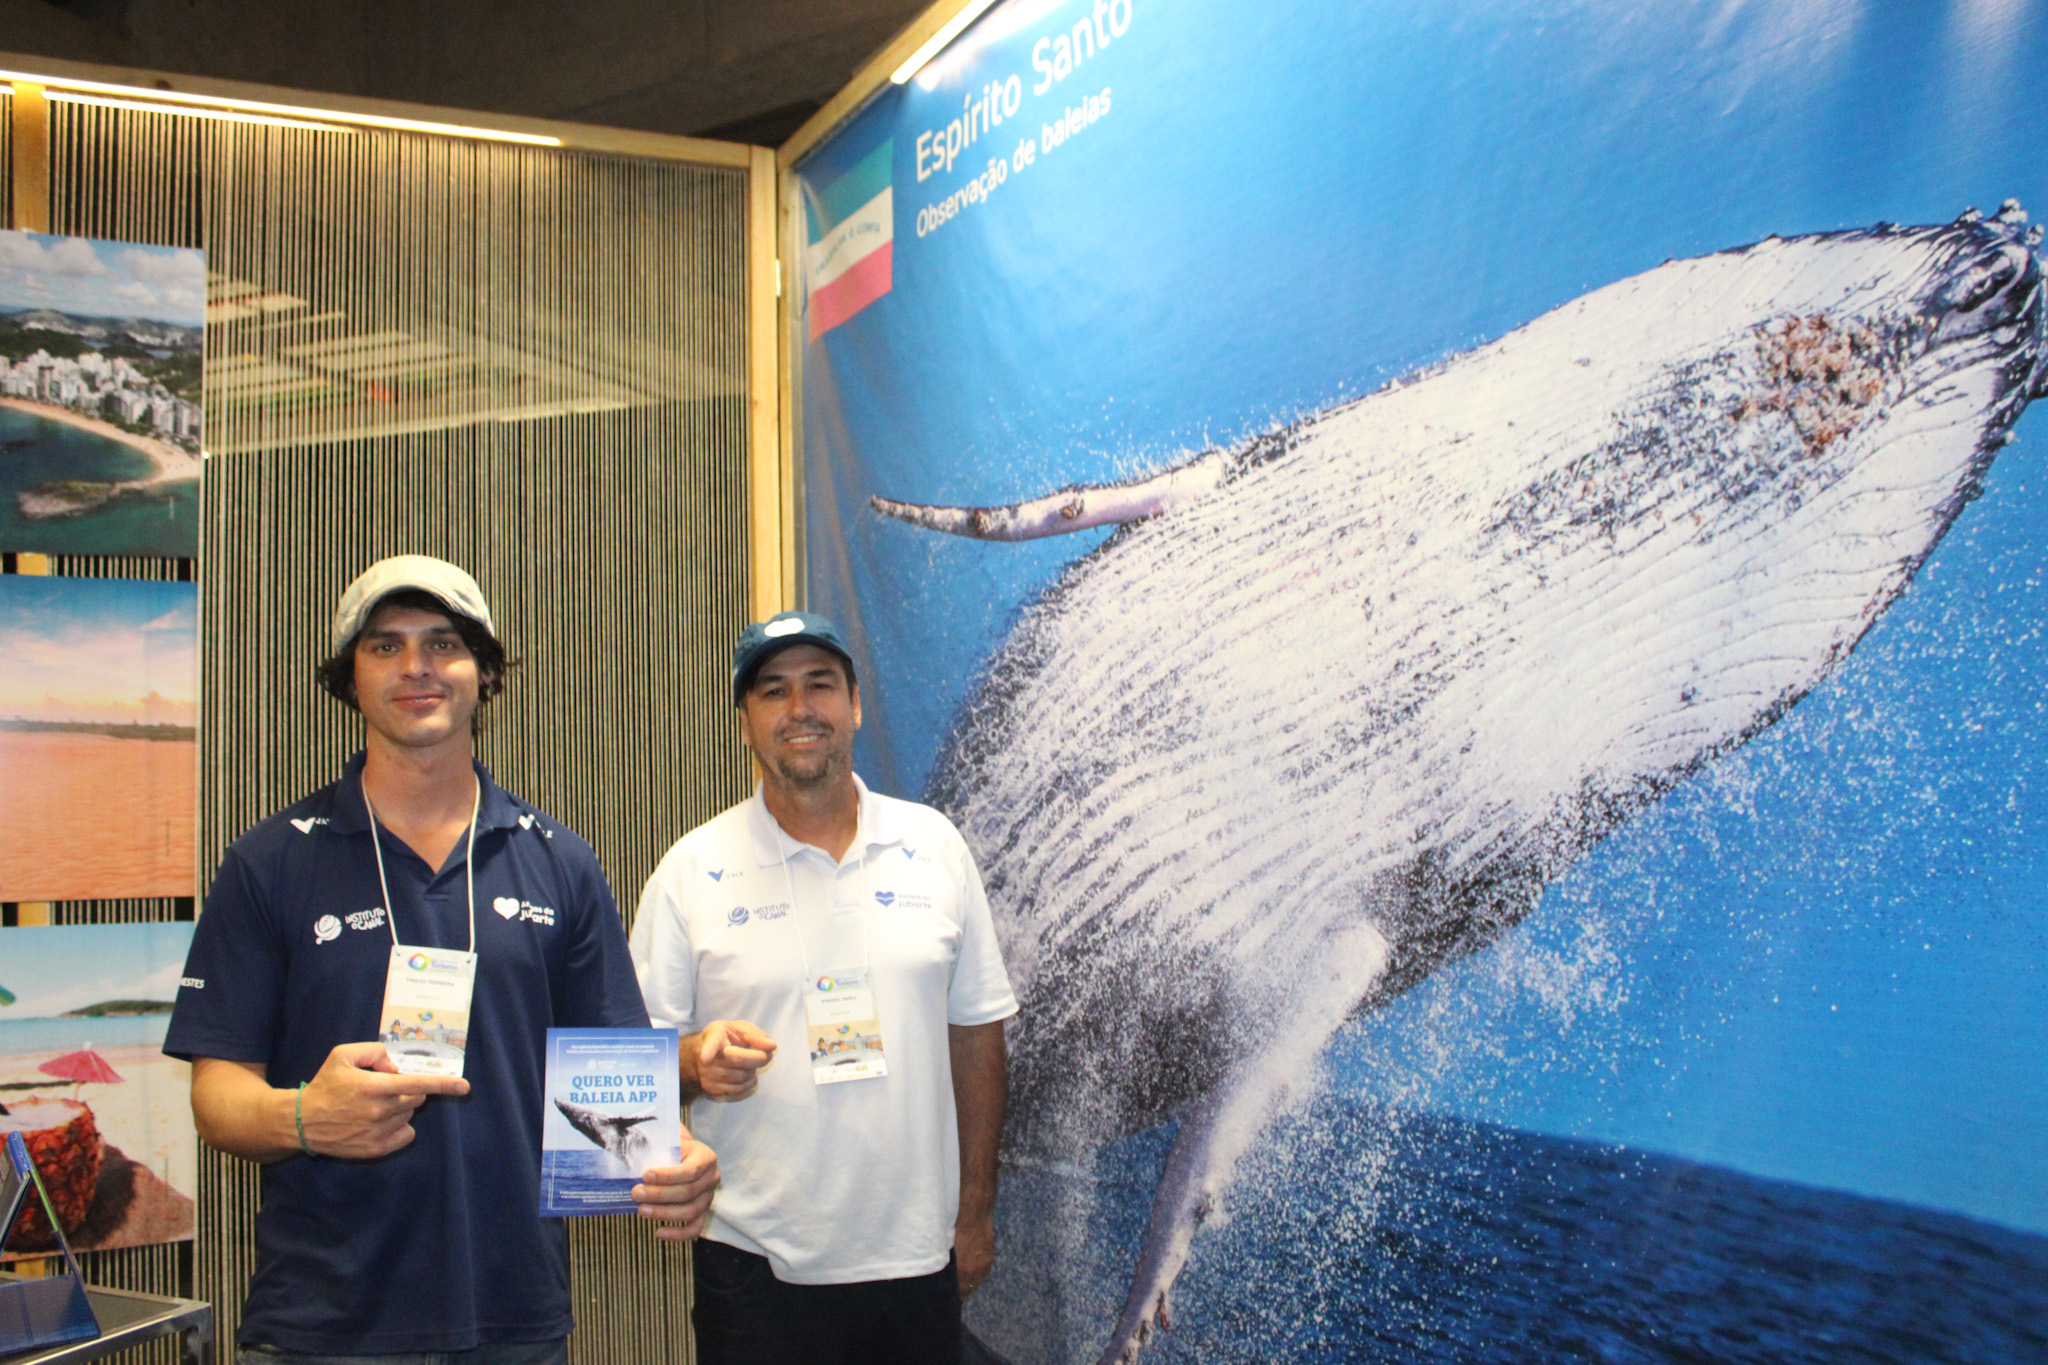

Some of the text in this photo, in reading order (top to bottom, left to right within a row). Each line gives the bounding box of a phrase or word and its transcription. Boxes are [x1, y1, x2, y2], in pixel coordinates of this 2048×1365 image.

[916, 0, 1133, 183] Espírito Santo
[916, 86, 1112, 238] Observação de baleias
[344, 907, 385, 924] INSTITUTO
[752, 903, 791, 915] INSTITUTO
[519, 909, 555, 926] Juarte
[180, 977, 205, 989] ESTES
[572, 1075, 655, 1090] QUERO VER
[569, 1091, 658, 1104] BALEIA APP
